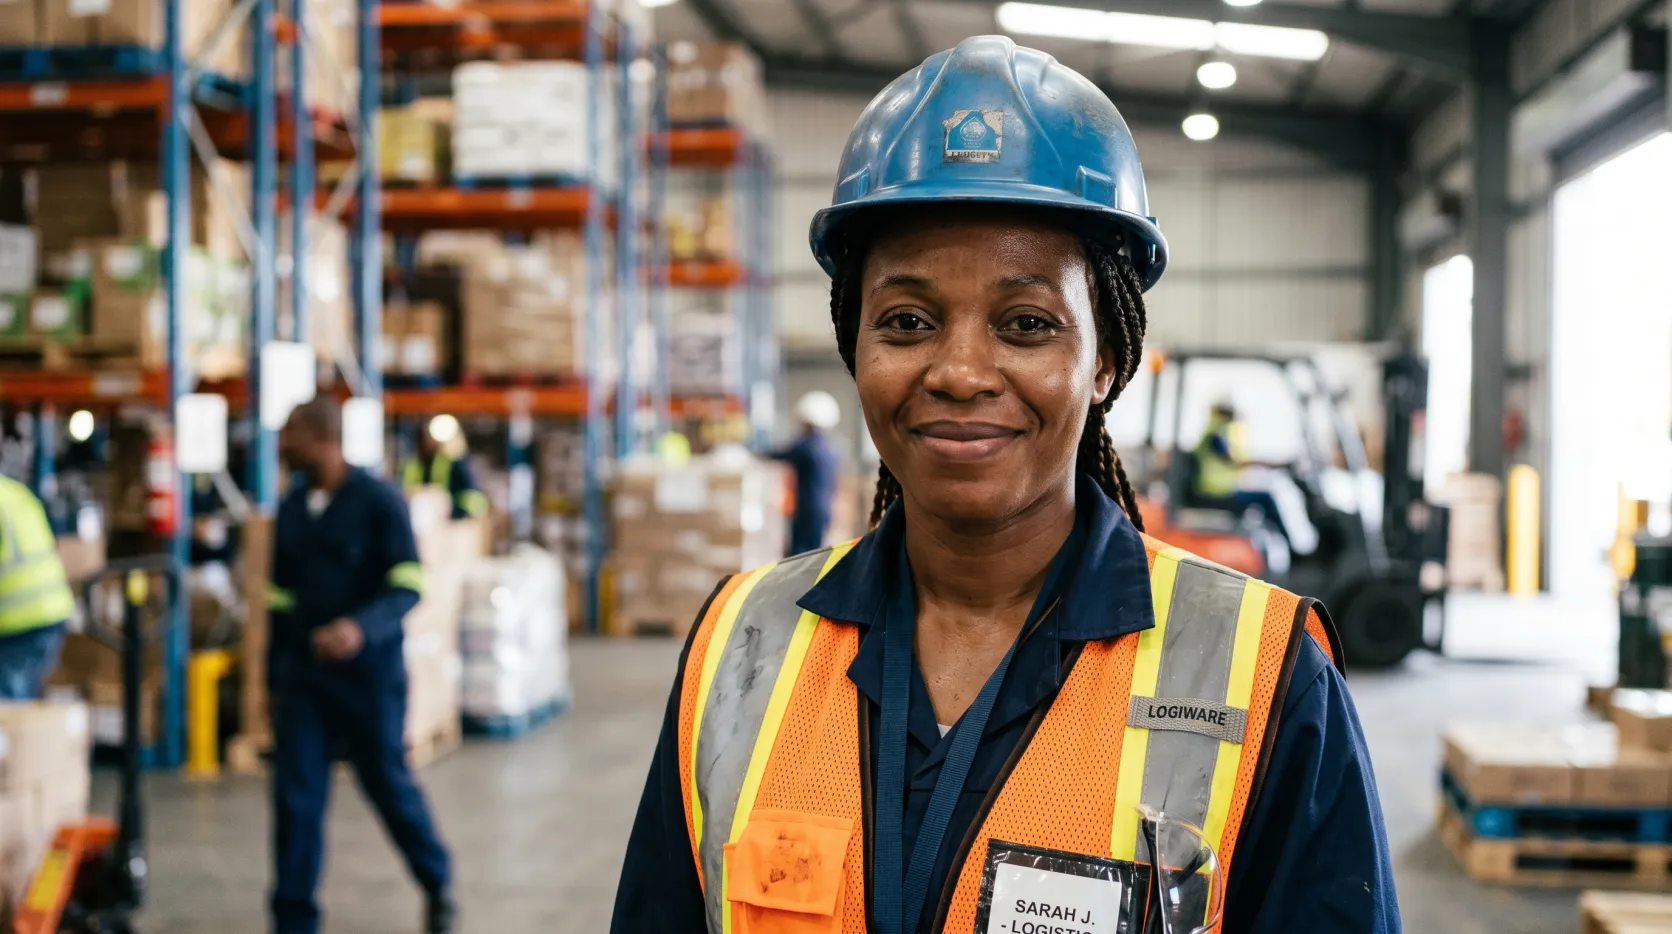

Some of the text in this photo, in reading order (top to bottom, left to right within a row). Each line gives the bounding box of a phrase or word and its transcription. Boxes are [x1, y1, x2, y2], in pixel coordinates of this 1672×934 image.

[1148, 705, 1227, 726] LOGIWARE
[1015, 899, 1095, 925] SARAH J.
